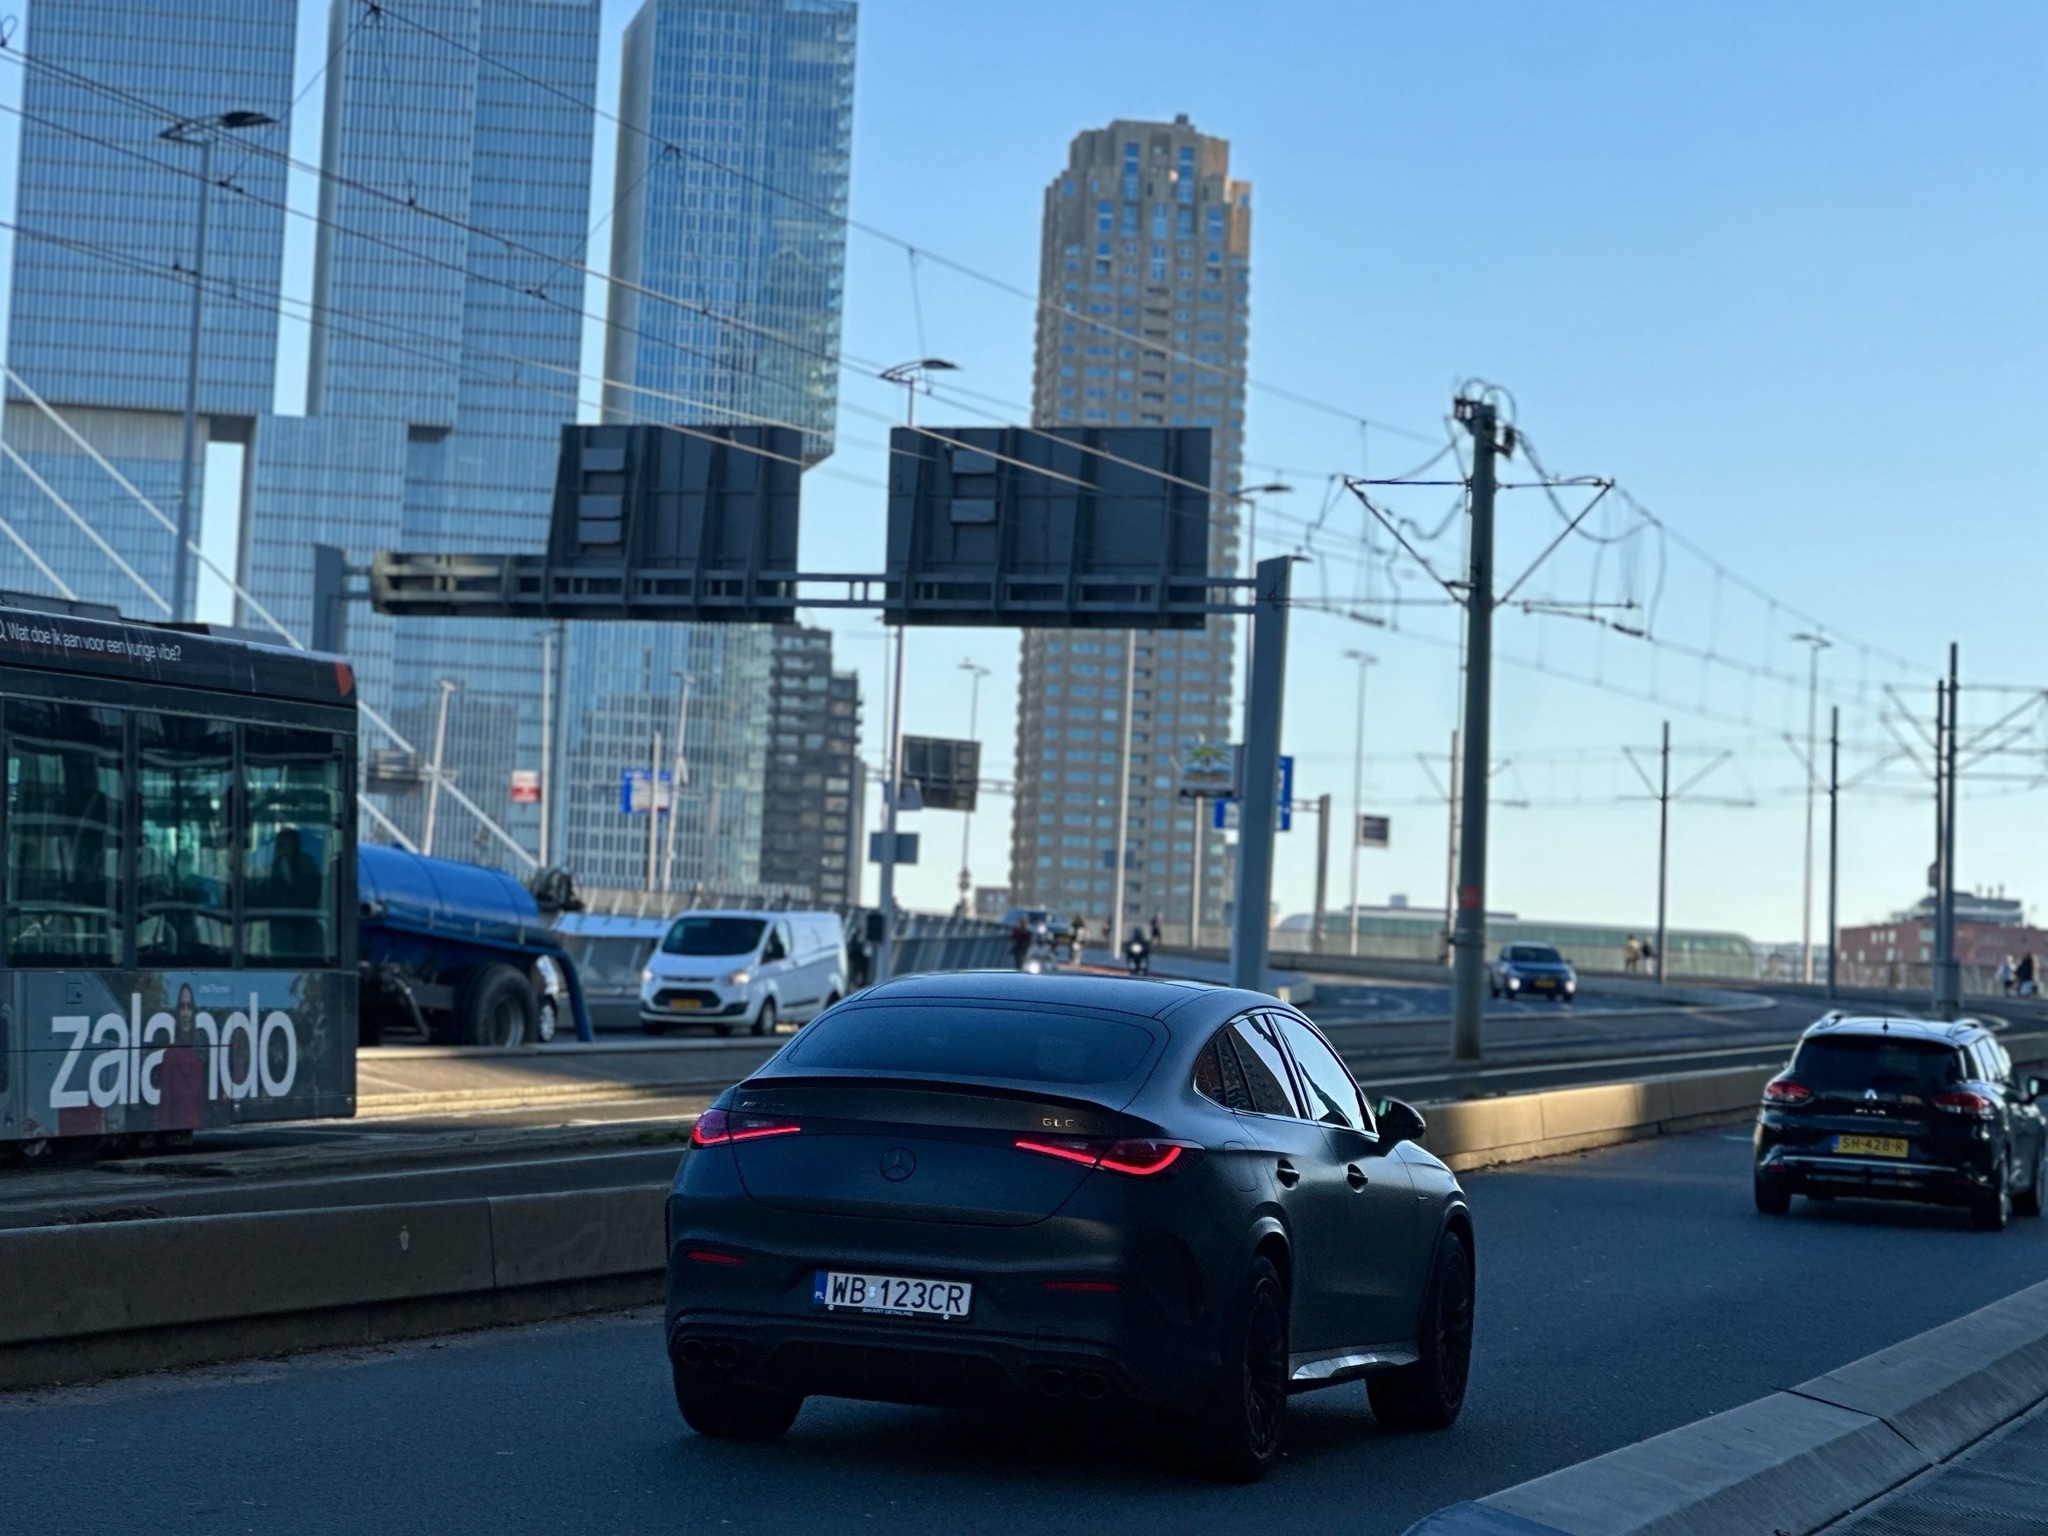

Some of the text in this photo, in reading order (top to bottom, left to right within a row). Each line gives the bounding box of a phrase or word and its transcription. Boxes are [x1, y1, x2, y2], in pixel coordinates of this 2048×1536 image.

[6, 621, 30, 641] Wat
[31, 625, 51, 645] doe
[51, 627, 63, 646] ik
[63, 633, 83, 649] aan
[82, 636, 105, 652] voor
[106, 639, 126, 654] een
[156, 643, 181, 661] vibe?
[50, 991, 297, 1108] zalando
[1042, 1117, 1075, 1128] GLC
[814, 1290, 825, 1300] PL
[832, 1275, 965, 1313] WB 123CR
